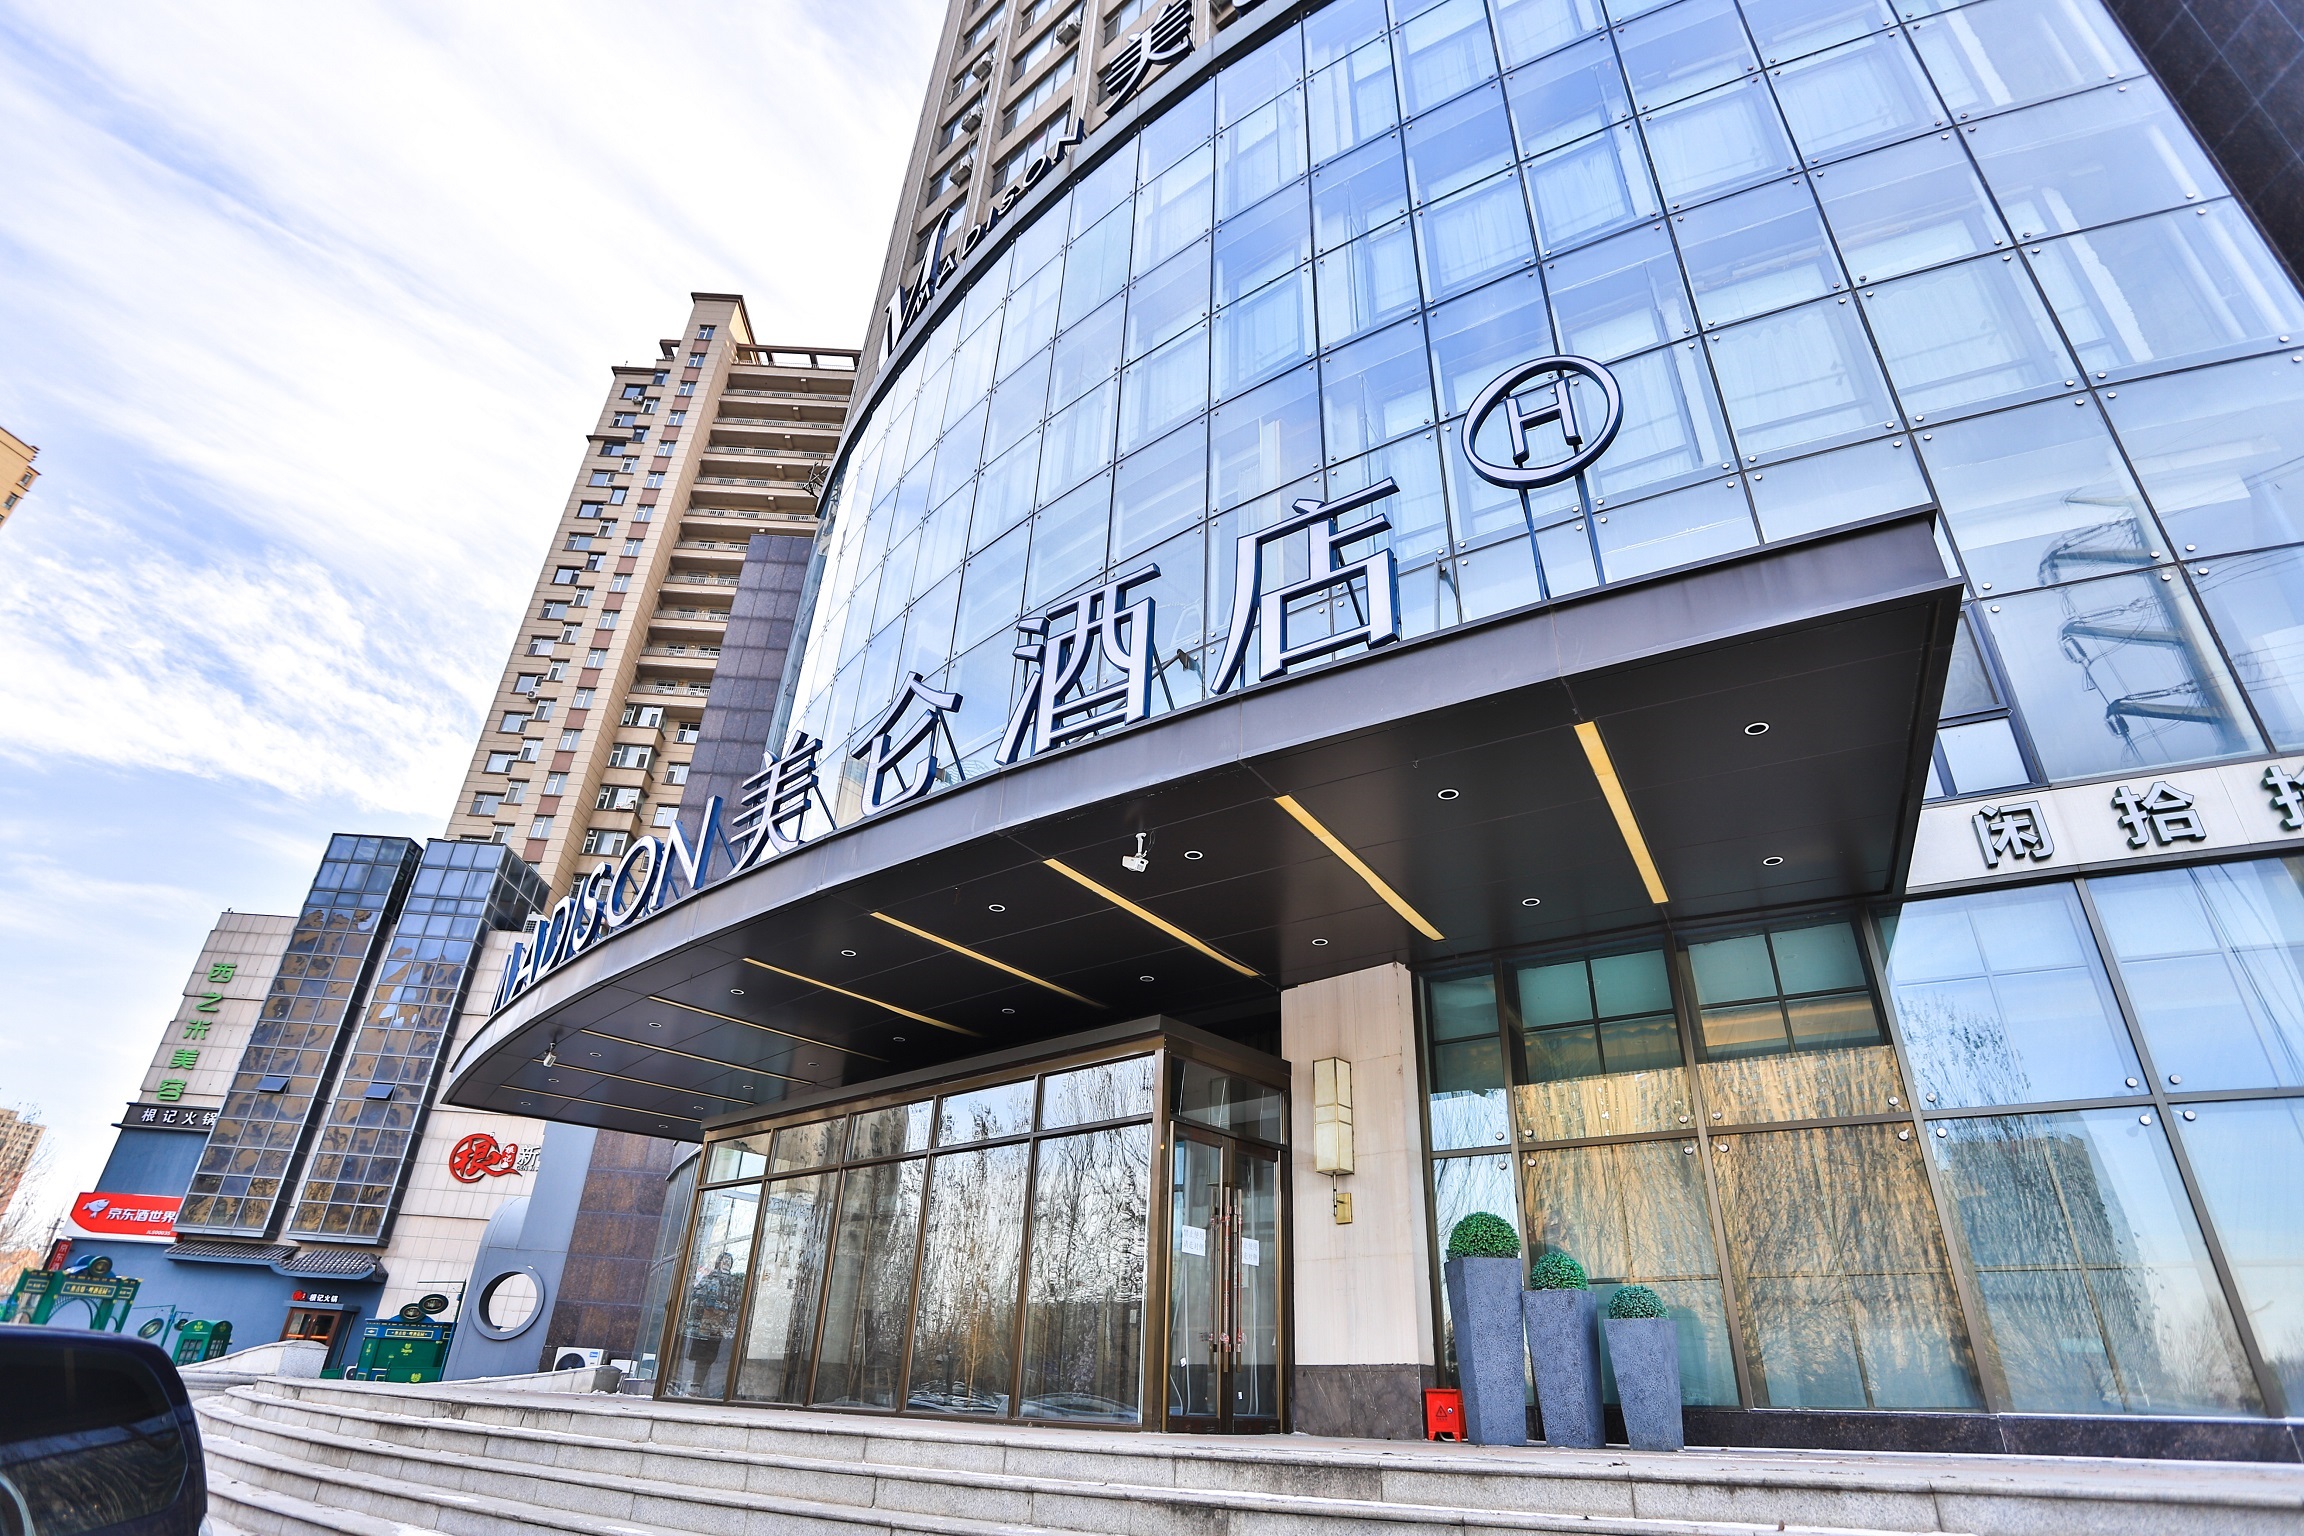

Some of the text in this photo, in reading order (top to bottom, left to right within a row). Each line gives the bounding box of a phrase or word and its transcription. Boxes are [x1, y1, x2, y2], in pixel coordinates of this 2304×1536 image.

[907, 117, 1084, 328] MADISON
[489, 477, 1399, 1018] MADISON 美仑酒店
[141, 1108, 219, 1127] 根记火锅
[106, 1207, 179, 1224] 京东酒世界
